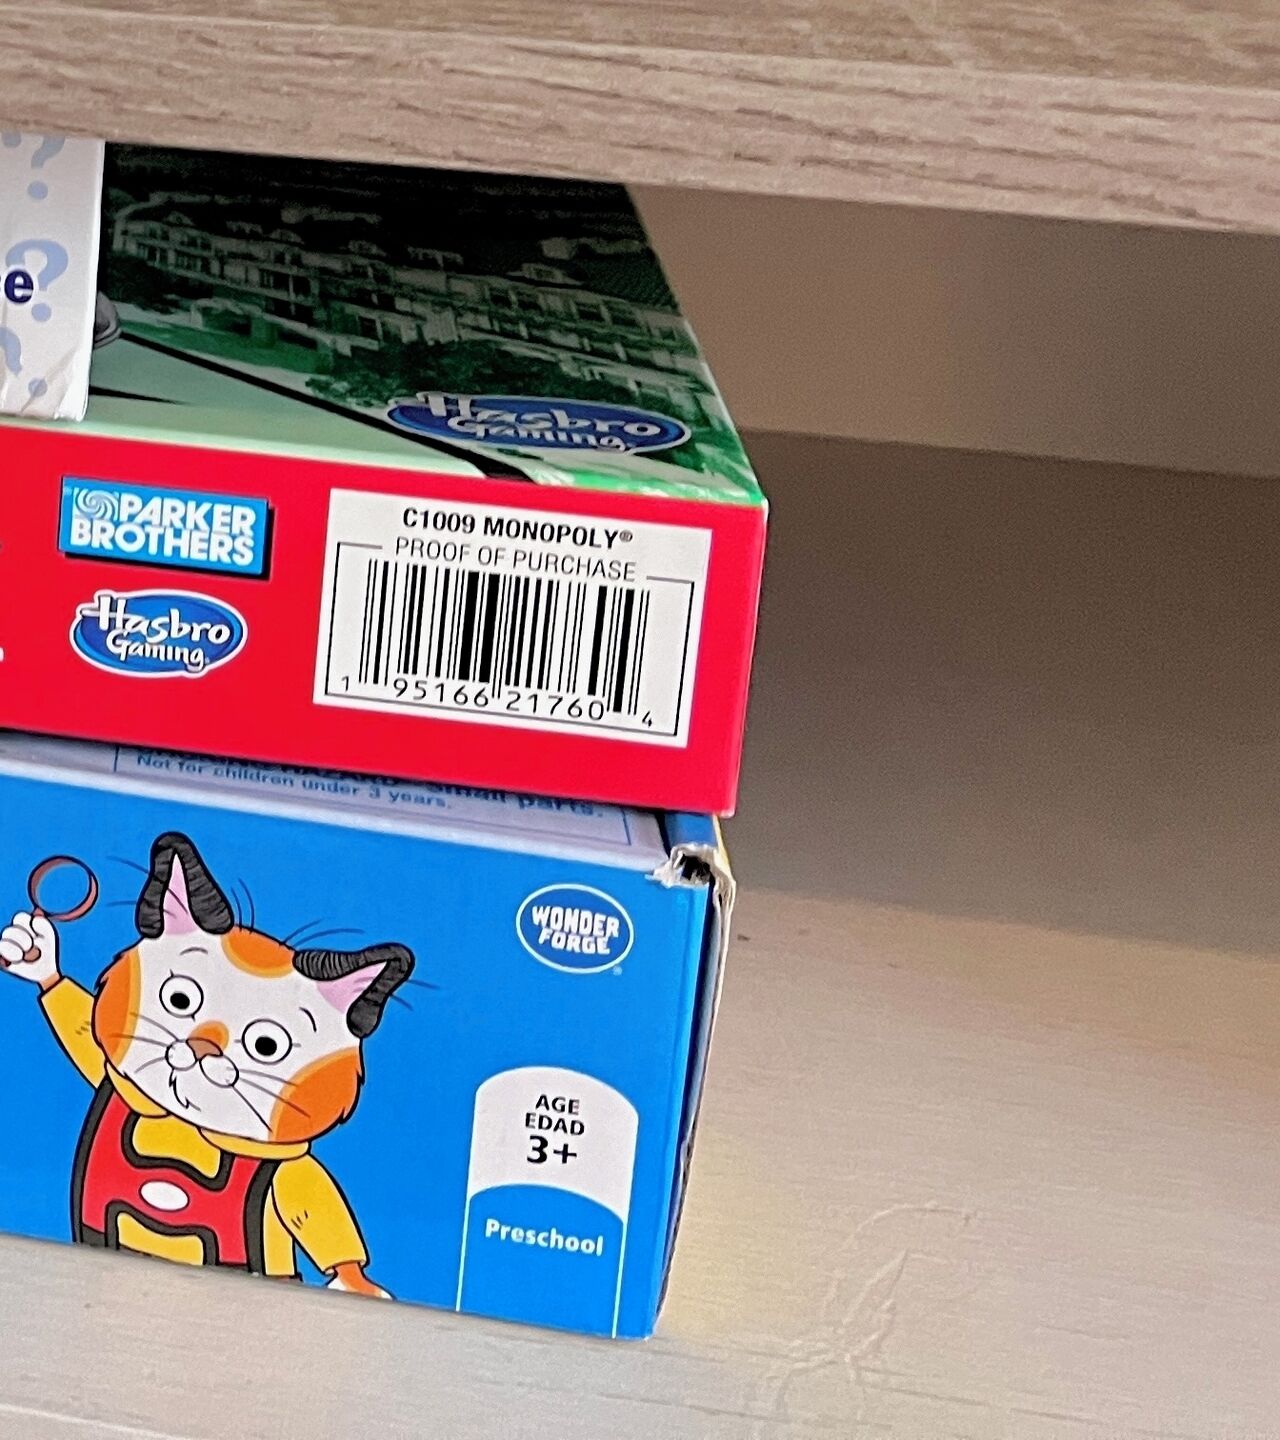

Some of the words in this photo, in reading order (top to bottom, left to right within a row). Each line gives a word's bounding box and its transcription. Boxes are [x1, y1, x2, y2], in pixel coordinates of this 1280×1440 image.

[414, 391, 662, 437] Hasbro
[447, 415, 627, 453] Gaming
[118, 492, 257, 538] PARKER
[402, 506, 476, 535] C1009
[69, 517, 256, 567] BROTHERS
[394, 535, 472, 563] PROOF
[477, 545, 507, 567] OF
[512, 551, 637, 583] PURCHASE
[80, 593, 231, 645] Hasbro
[105, 628, 205, 672] Gaming
[340, 675, 351, 692] 1
[392, 677, 490, 708] 95166
[505, 689, 605, 722] 21760
[641, 711, 655, 728] 4
[136, 754, 171, 770] Not
[178, 761, 205, 775] for
[212, 765, 295, 788] children
[301, 777, 360, 798] under
[368, 785, 381, 800] 3
[531, 905, 621, 939] WONDER
[538, 927, 611, 956] FORGE
[525, 1112, 586, 1137] EDAD
[535, 1093, 581, 1116] AGE
[526, 1134, 578, 1165] 3+
[484, 1217, 604, 1257] Preschool
